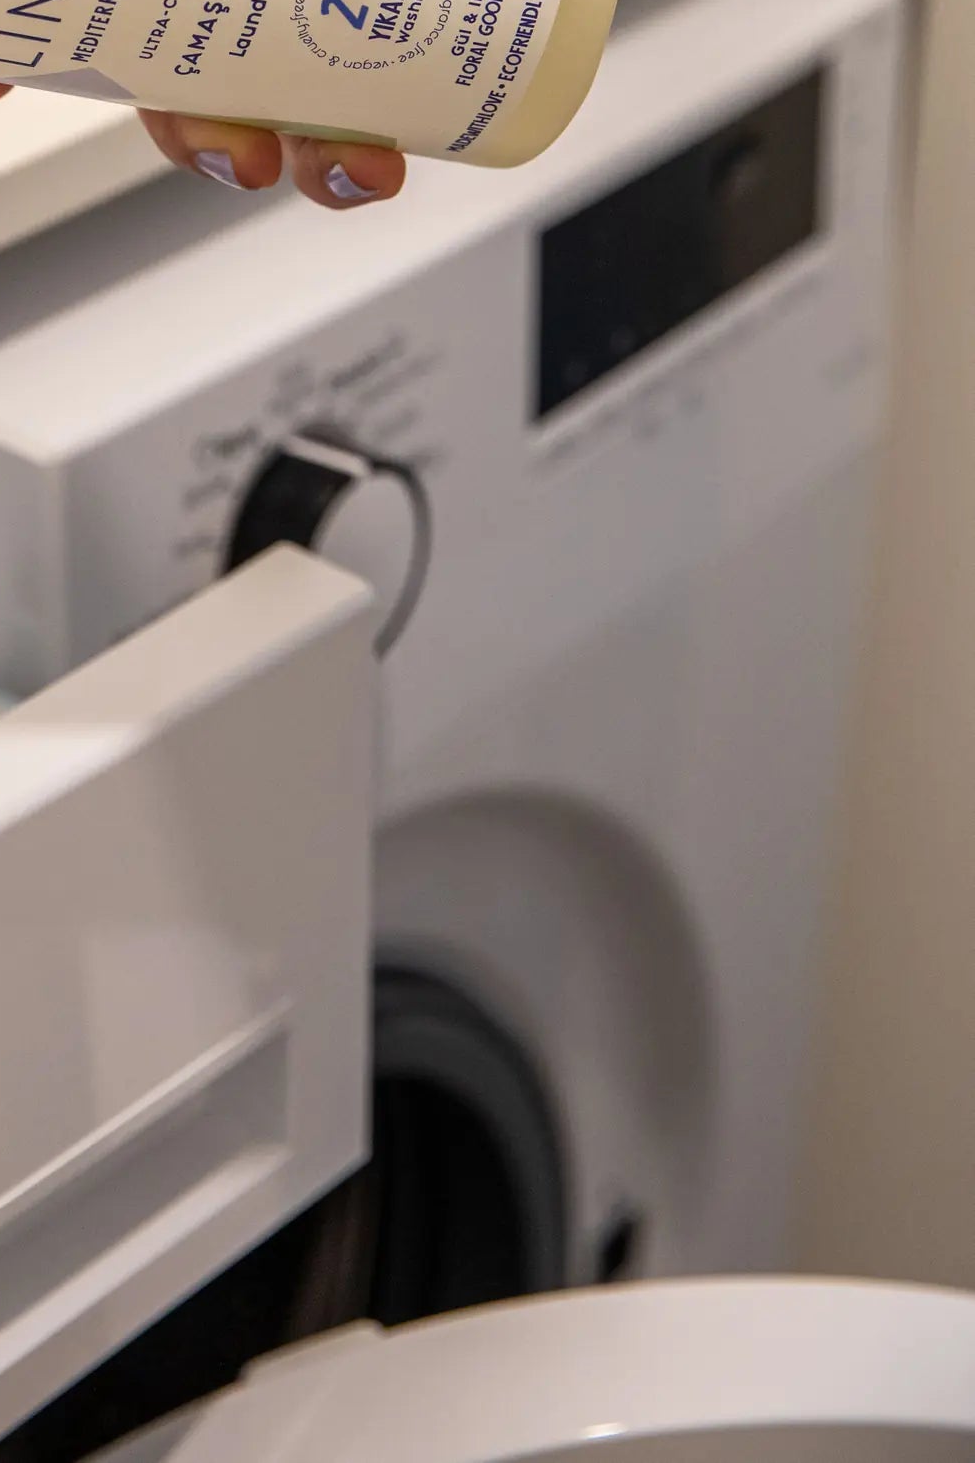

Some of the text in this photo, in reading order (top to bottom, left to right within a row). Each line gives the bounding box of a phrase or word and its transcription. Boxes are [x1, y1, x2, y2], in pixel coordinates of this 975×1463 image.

[451, 29, 472, 56] Gül
[463, 14, 477, 24] &
[328, 55, 340, 66] &
[398, 42, 425, 63] free
[343, 59, 389, 70] vegan
[455, 41, 489, 86] FLORAL
